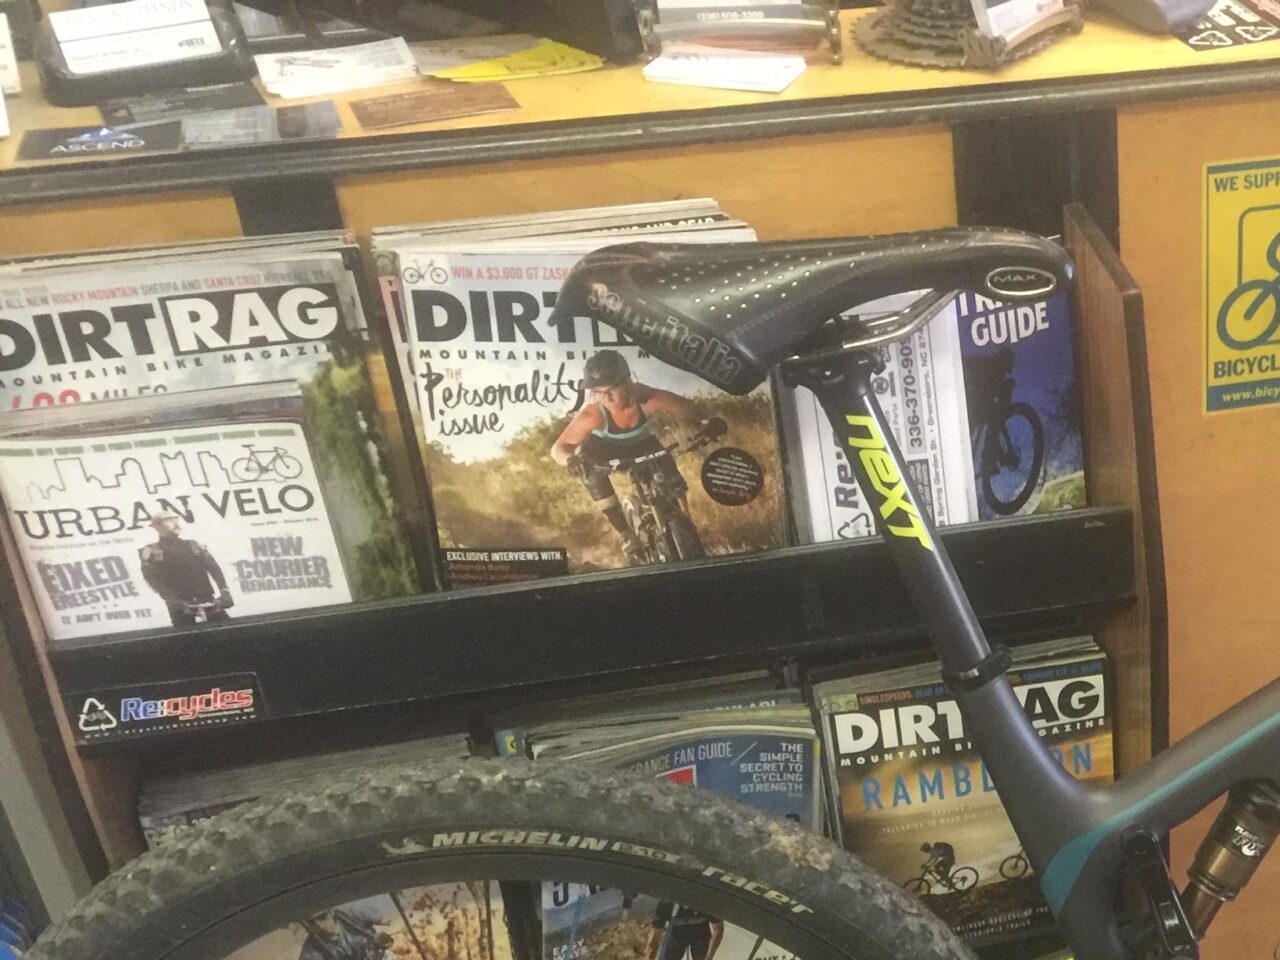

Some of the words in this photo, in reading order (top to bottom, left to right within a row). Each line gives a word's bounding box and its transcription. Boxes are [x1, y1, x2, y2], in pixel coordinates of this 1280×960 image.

[50, 138, 146, 153] ASCEND
[1214, 176, 1239, 193] WE
[452, 267, 473, 281] WIN
[477, 268, 485, 280] A
[487, 267, 523, 281] $3,000
[526, 266, 539, 280] GT
[542, 265, 571, 280] ZASK
[993, 274, 1037, 283] MAX
[166, 287, 338, 352] RAG
[971, 301, 1049, 346] GUIDE
[420, 349, 547, 361] MOUNTAIN
[664, 314, 742, 384] italia
[147, 356, 203, 373] BIKE
[921, 355, 929, 368] NC
[444, 367, 463, 381] THE
[419, 362, 586, 421] Personality
[439, 408, 505, 437] issue
[15, 494, 195, 540] URBAN
[202, 484, 315, 518] VELO
[250, 536, 304, 557] NEW
[446, 551, 489, 562] EXCLUSIVE
[491, 551, 539, 562] INTERVIEWS
[37, 555, 130, 592] FIXED
[234, 555, 331, 580] COURIER
[240, 574, 333, 594] RENAISSANCE
[49, 580, 140, 611] FREESTYLE
[134, 607, 152, 618] YET
[121, 688, 254, 721] Re:cycles
[1021, 680, 1102, 725] AG
[780, 742, 804, 753] THE
[840, 744, 941, 767] MOUNTAIN
[1038, 717, 1106, 737] GAZINE
[673, 747, 696, 766] FAN
[698, 741, 733, 761] GUIDE
[759, 752, 804, 763] SIMPLE
[739, 762, 785, 774] SECRET
[788, 762, 804, 773] TO
[752, 773, 804, 783] CYCLING
[739, 783, 804, 794] STRENGTH
[861, 758, 996, 812] RAMBL
[432, 831, 609, 852] MICHELIN
